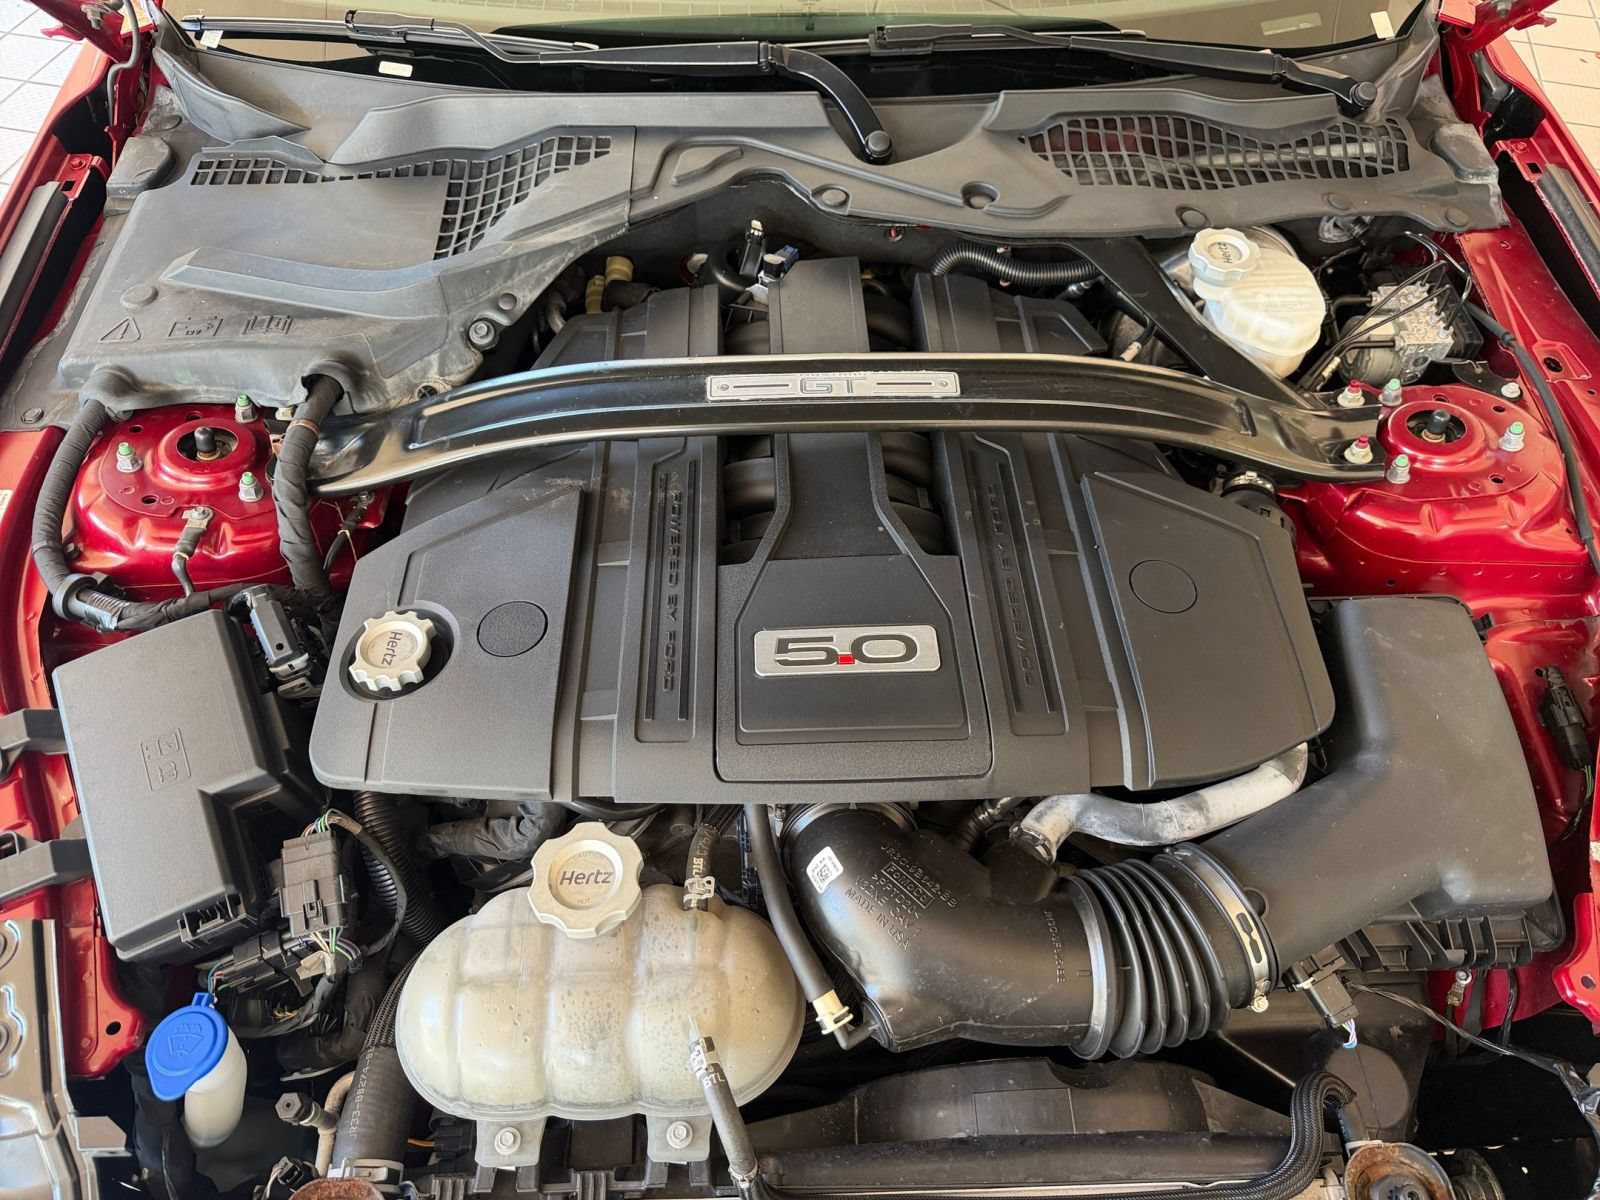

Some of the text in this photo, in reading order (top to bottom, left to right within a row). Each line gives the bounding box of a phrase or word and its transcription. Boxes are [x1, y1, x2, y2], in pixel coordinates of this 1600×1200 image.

[800, 376, 867, 394] GT
[997, 543, 1011, 571] BY
[663, 491, 682, 692] POWERED BY FORD
[381, 631, 403, 666] Hertz
[1004, 576, 1032, 687] POWERED
[774, 634, 918, 667] 5.0
[573, 850, 606, 860] CAUTION
[559, 869, 614, 886] Hertz
[886, 865, 928, 903] FoMoCo
[844, 886, 911, 950] MADE IN USA
